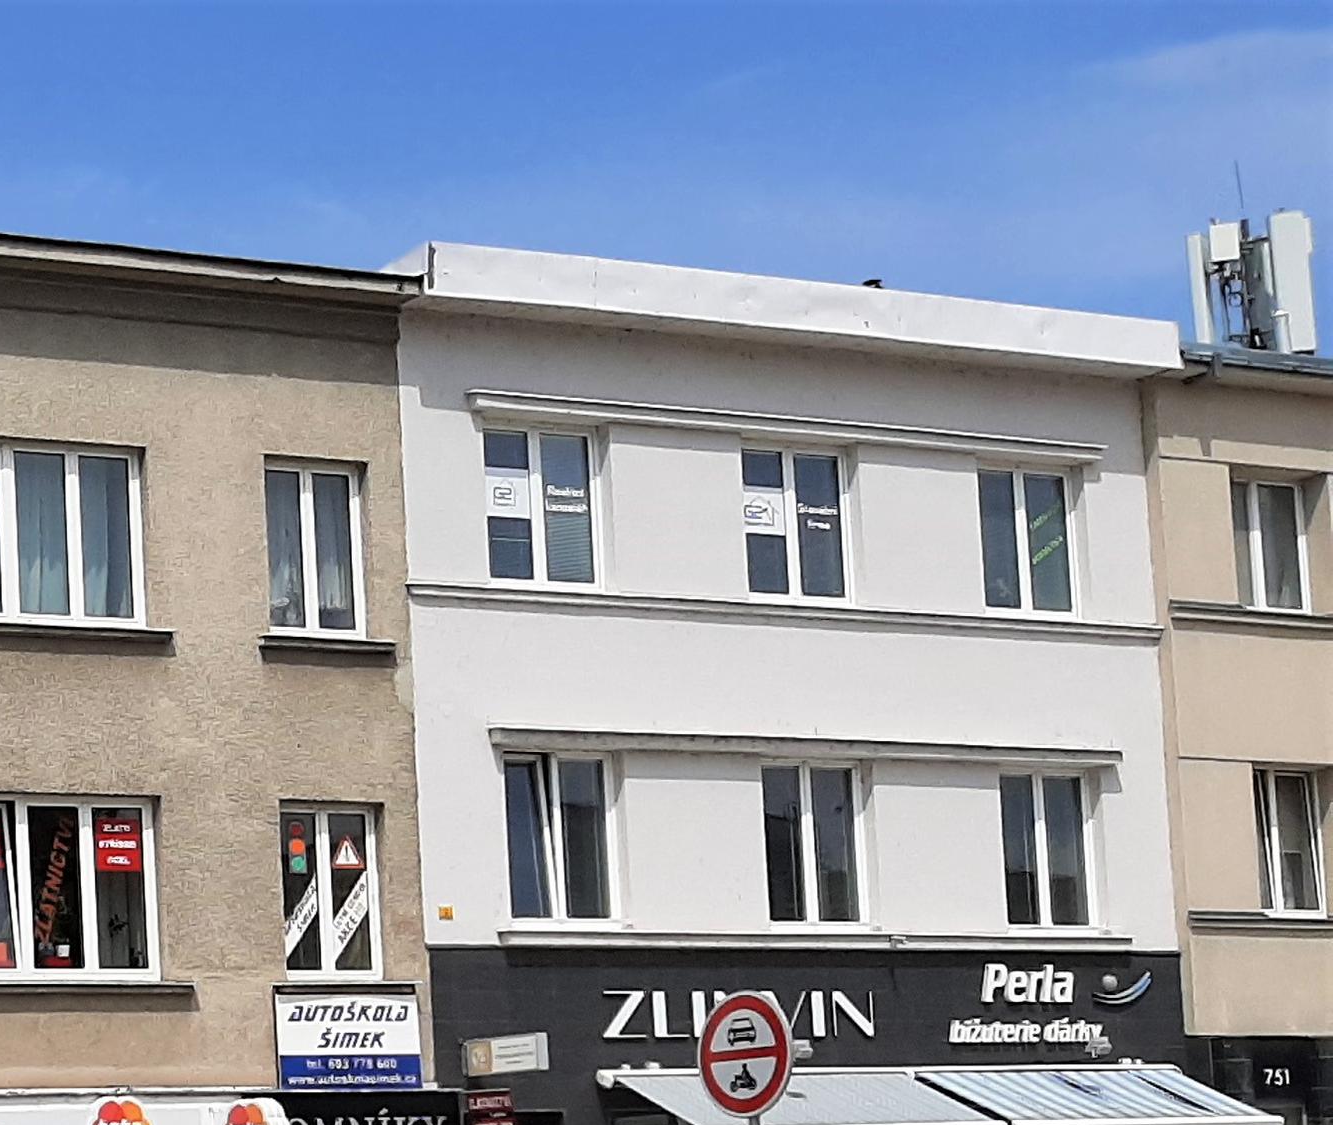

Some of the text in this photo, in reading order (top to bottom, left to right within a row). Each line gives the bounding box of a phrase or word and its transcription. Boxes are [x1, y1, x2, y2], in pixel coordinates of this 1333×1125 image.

[981, 963, 1074, 1003] Perla
[287, 1001, 409, 1022] AUTOŠKOLA
[317, 1027, 385, 1049] ŠIMEK
[949, 1018, 1042, 1044] bižuterie
[1263, 1068, 1290, 1086] 751
